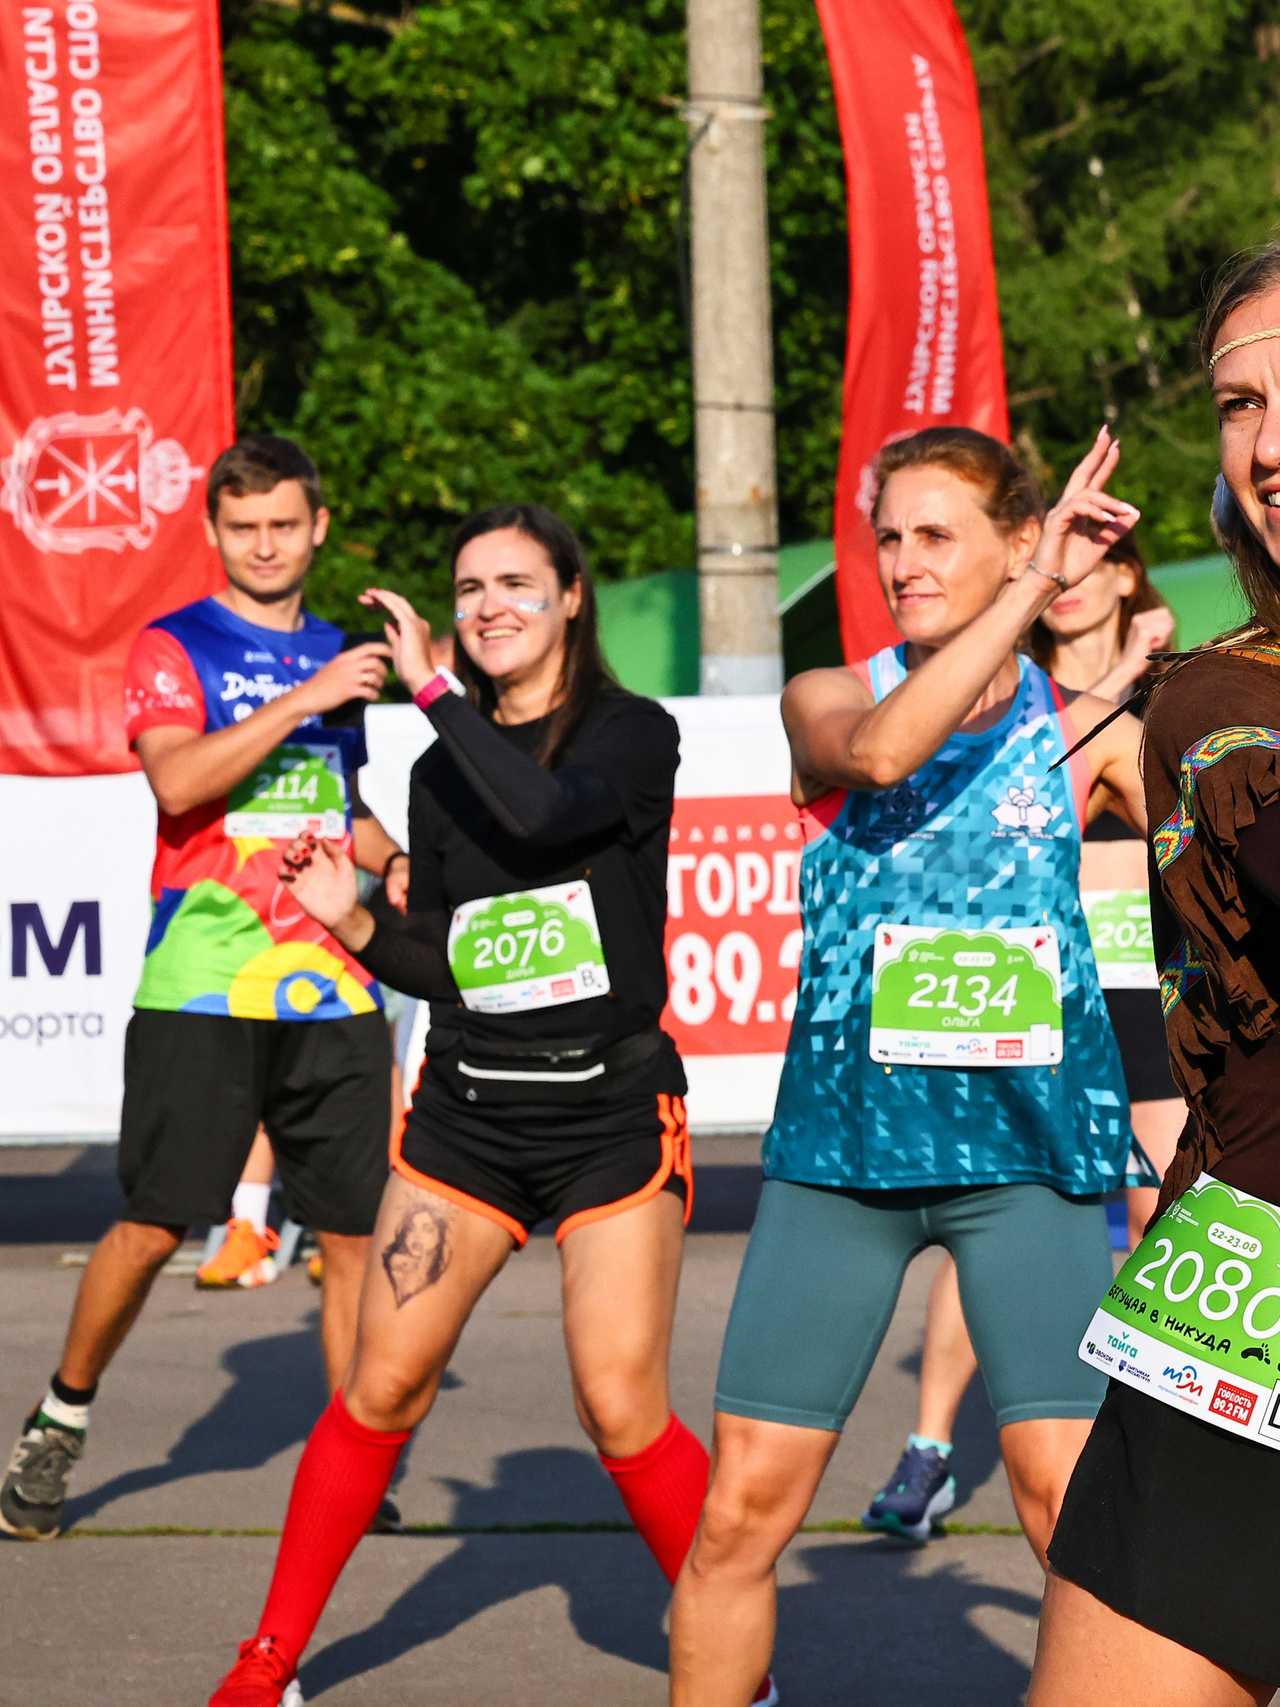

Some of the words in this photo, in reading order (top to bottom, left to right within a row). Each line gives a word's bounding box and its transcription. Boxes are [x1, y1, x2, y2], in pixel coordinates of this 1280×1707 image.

[253, 773, 318, 805] 2114
[473, 918, 566, 970] 2076
[1093, 920, 1153, 949] 202
[907, 972, 1018, 1017] 2134
[941, 1016, 981, 1028] ОЛЬГА
[1211, 1227, 1259, 1253] 22-23.08
[1106, 1331, 1139, 1359] тайга
[1149, 1309, 1160, 1324] В
[1164, 1315, 1232, 1354] НИКУДА
[1213, 1397, 1234, 1415] 89.2
[1232, 1404, 1250, 1421] FM
